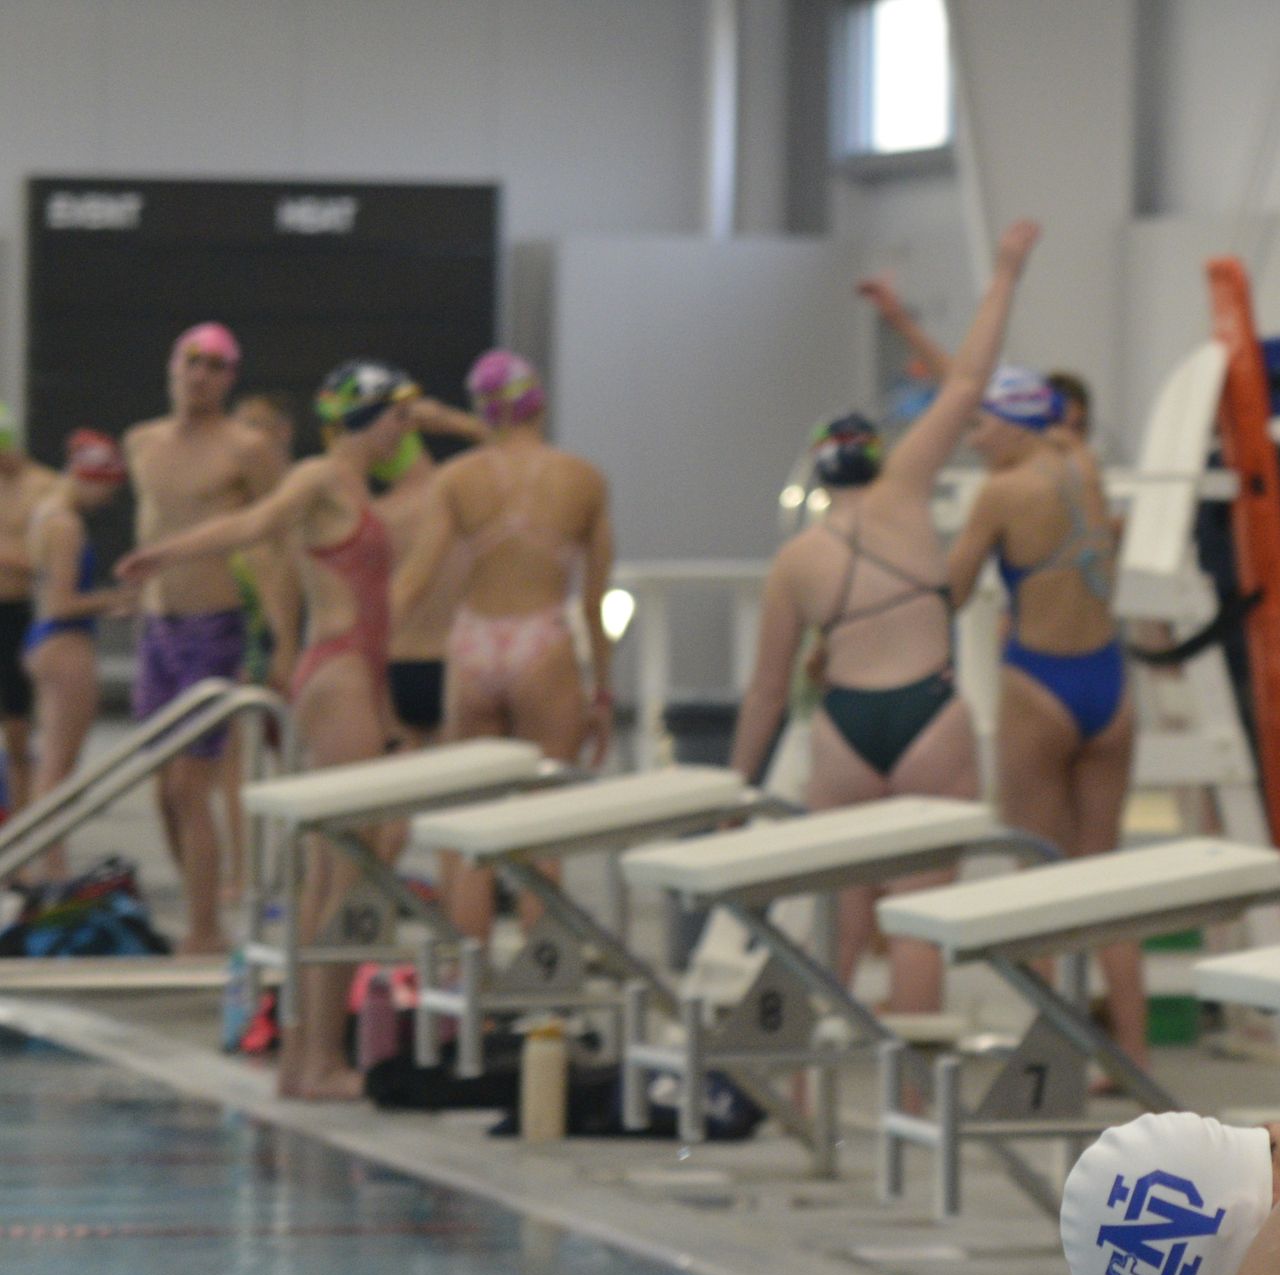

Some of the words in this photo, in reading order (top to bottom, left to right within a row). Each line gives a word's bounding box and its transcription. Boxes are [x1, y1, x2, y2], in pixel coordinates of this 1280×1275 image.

[534, 941, 559, 979] 9
[759, 988, 783, 1033] 8
[1024, 1063, 1048, 1110] 7
